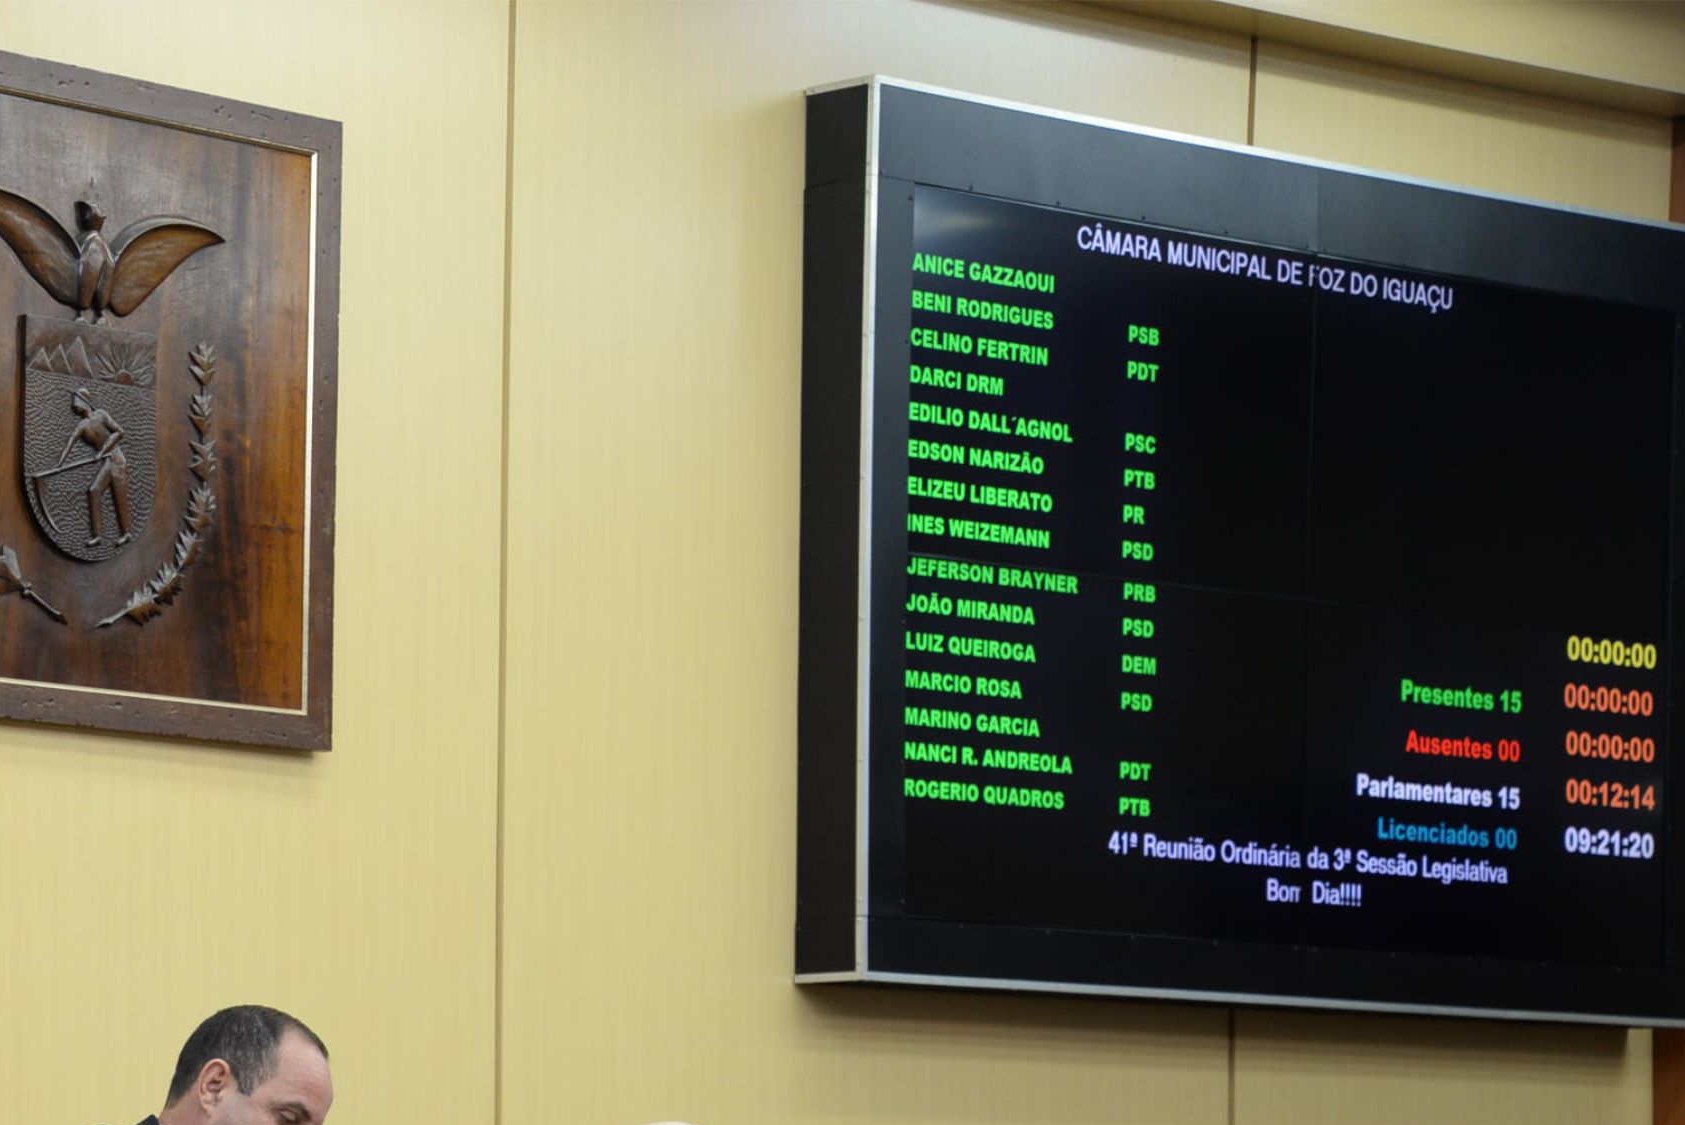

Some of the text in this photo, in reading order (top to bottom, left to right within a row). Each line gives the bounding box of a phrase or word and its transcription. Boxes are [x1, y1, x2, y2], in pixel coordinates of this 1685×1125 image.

[912, 253, 1055, 293] ANICE GAZZAOUI
[1077, 223, 1453, 313] CÂMARA MUNICIPAL DE FOZ DO IGUAÇU
[912, 290, 1054, 330] BENI RODRIGUES
[910, 328, 1049, 366] CELINO FERTRIN
[1128, 324, 1160, 346] PSB
[910, 365, 1004, 396] DARCI DRM
[1127, 361, 1159, 382] PDT
[908, 402, 964, 427] EDILIO
[907, 439, 1045, 475] EDSON NARIZÃO
[1125, 433, 1156, 454] PSC
[907, 476, 1053, 513] ELIZEU LIBERATO
[1124, 468, 1156, 490] PTB
[907, 513, 1050, 549] INES WEIZEMANN
[1123, 504, 1145, 525] PR
[1122, 541, 1154, 561] PSD
[907, 557, 1079, 594] JEFERSON BRAYNER
[906, 592, 1035, 625] JOÃO MIRANDA
[1123, 582, 1156, 603] PRB
[1122, 618, 1154, 638] PSD
[905, 631, 1036, 663] LUIZ QUEIROGA
[1567, 635, 1657, 670] 00:00:00
[1121, 655, 1157, 675] DEM
[905, 669, 1022, 700] MARCIO ROSA
[1401, 678, 1522, 714] Presentes 15
[1564, 683, 1654, 717] 00:00:00
[1121, 692, 1153, 712] PSD
[905, 707, 1040, 738] MARINO GARCIA
[904, 741, 1073, 775] NANCI R. ANDREOLA
[1405, 730, 1521, 763] Ausentes 00
[1566, 730, 1655, 764] 00:00:00
[1119, 761, 1151, 781] PDT
[904, 778, 1065, 810] ROGERIO QUADROS
[1119, 797, 1151, 817] PTB
[1356, 772, 1521, 810] Parlamentares 15
[1566, 778, 1655, 812] 00:12:14
[1377, 816, 1517, 850] Licenciados 00
[1564, 826, 1655, 859] 09:21:20
[1108, 831, 1508, 885] 41ª Reunião Ordinária da 3ª Sessão Legislativa
[1312, 881, 1363, 907] Dia!!!!
